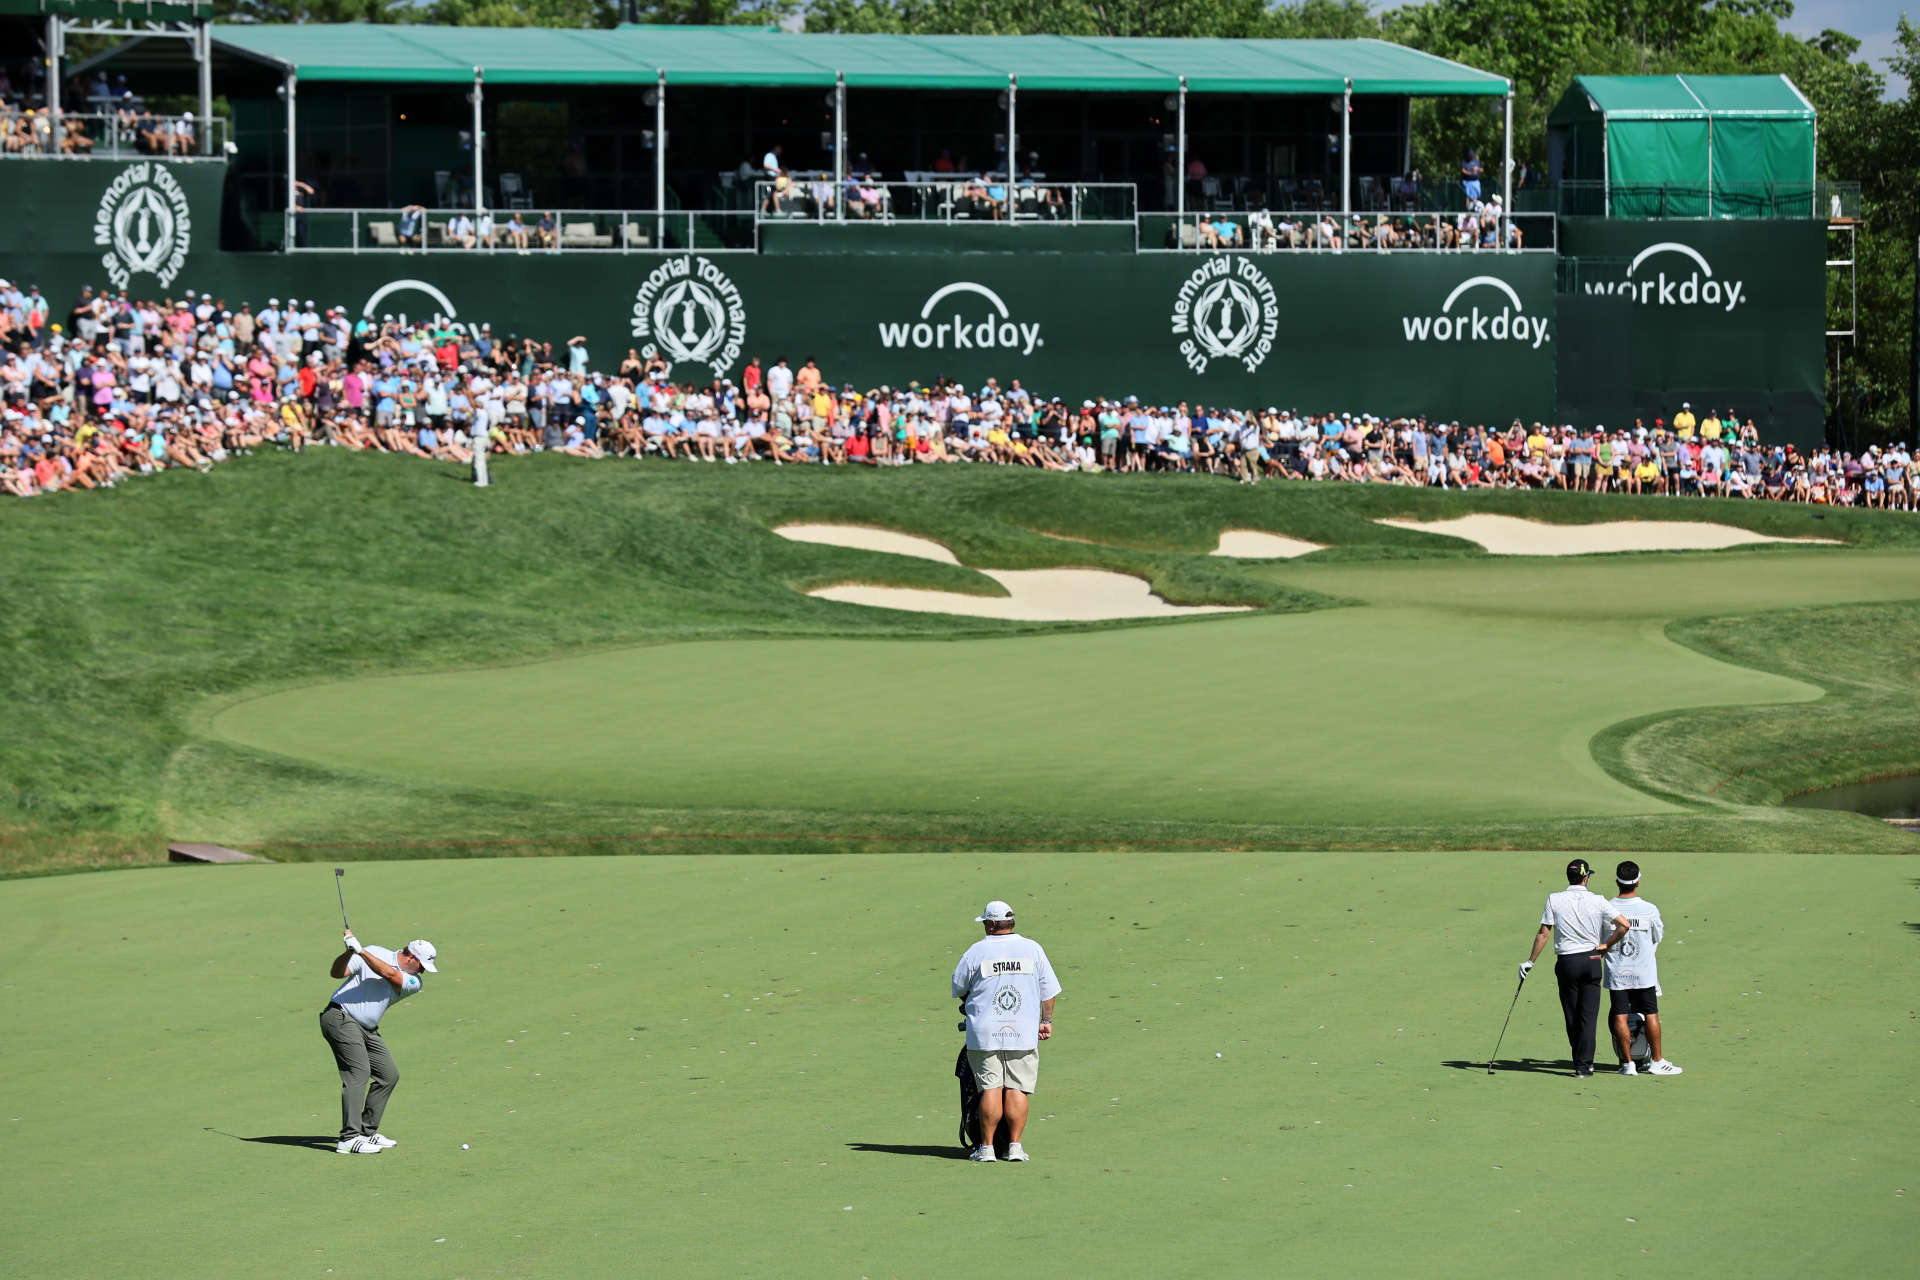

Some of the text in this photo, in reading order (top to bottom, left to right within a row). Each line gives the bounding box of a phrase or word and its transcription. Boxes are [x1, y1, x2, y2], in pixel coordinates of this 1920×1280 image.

[94, 161, 191, 290] the Memorial Tournament
[630, 254, 690, 338] Memorial
[696, 256, 746, 379] Tournament
[1171, 254, 1278, 375] the Memorial Tournament
[992, 961, 1021, 973] STRAKA
